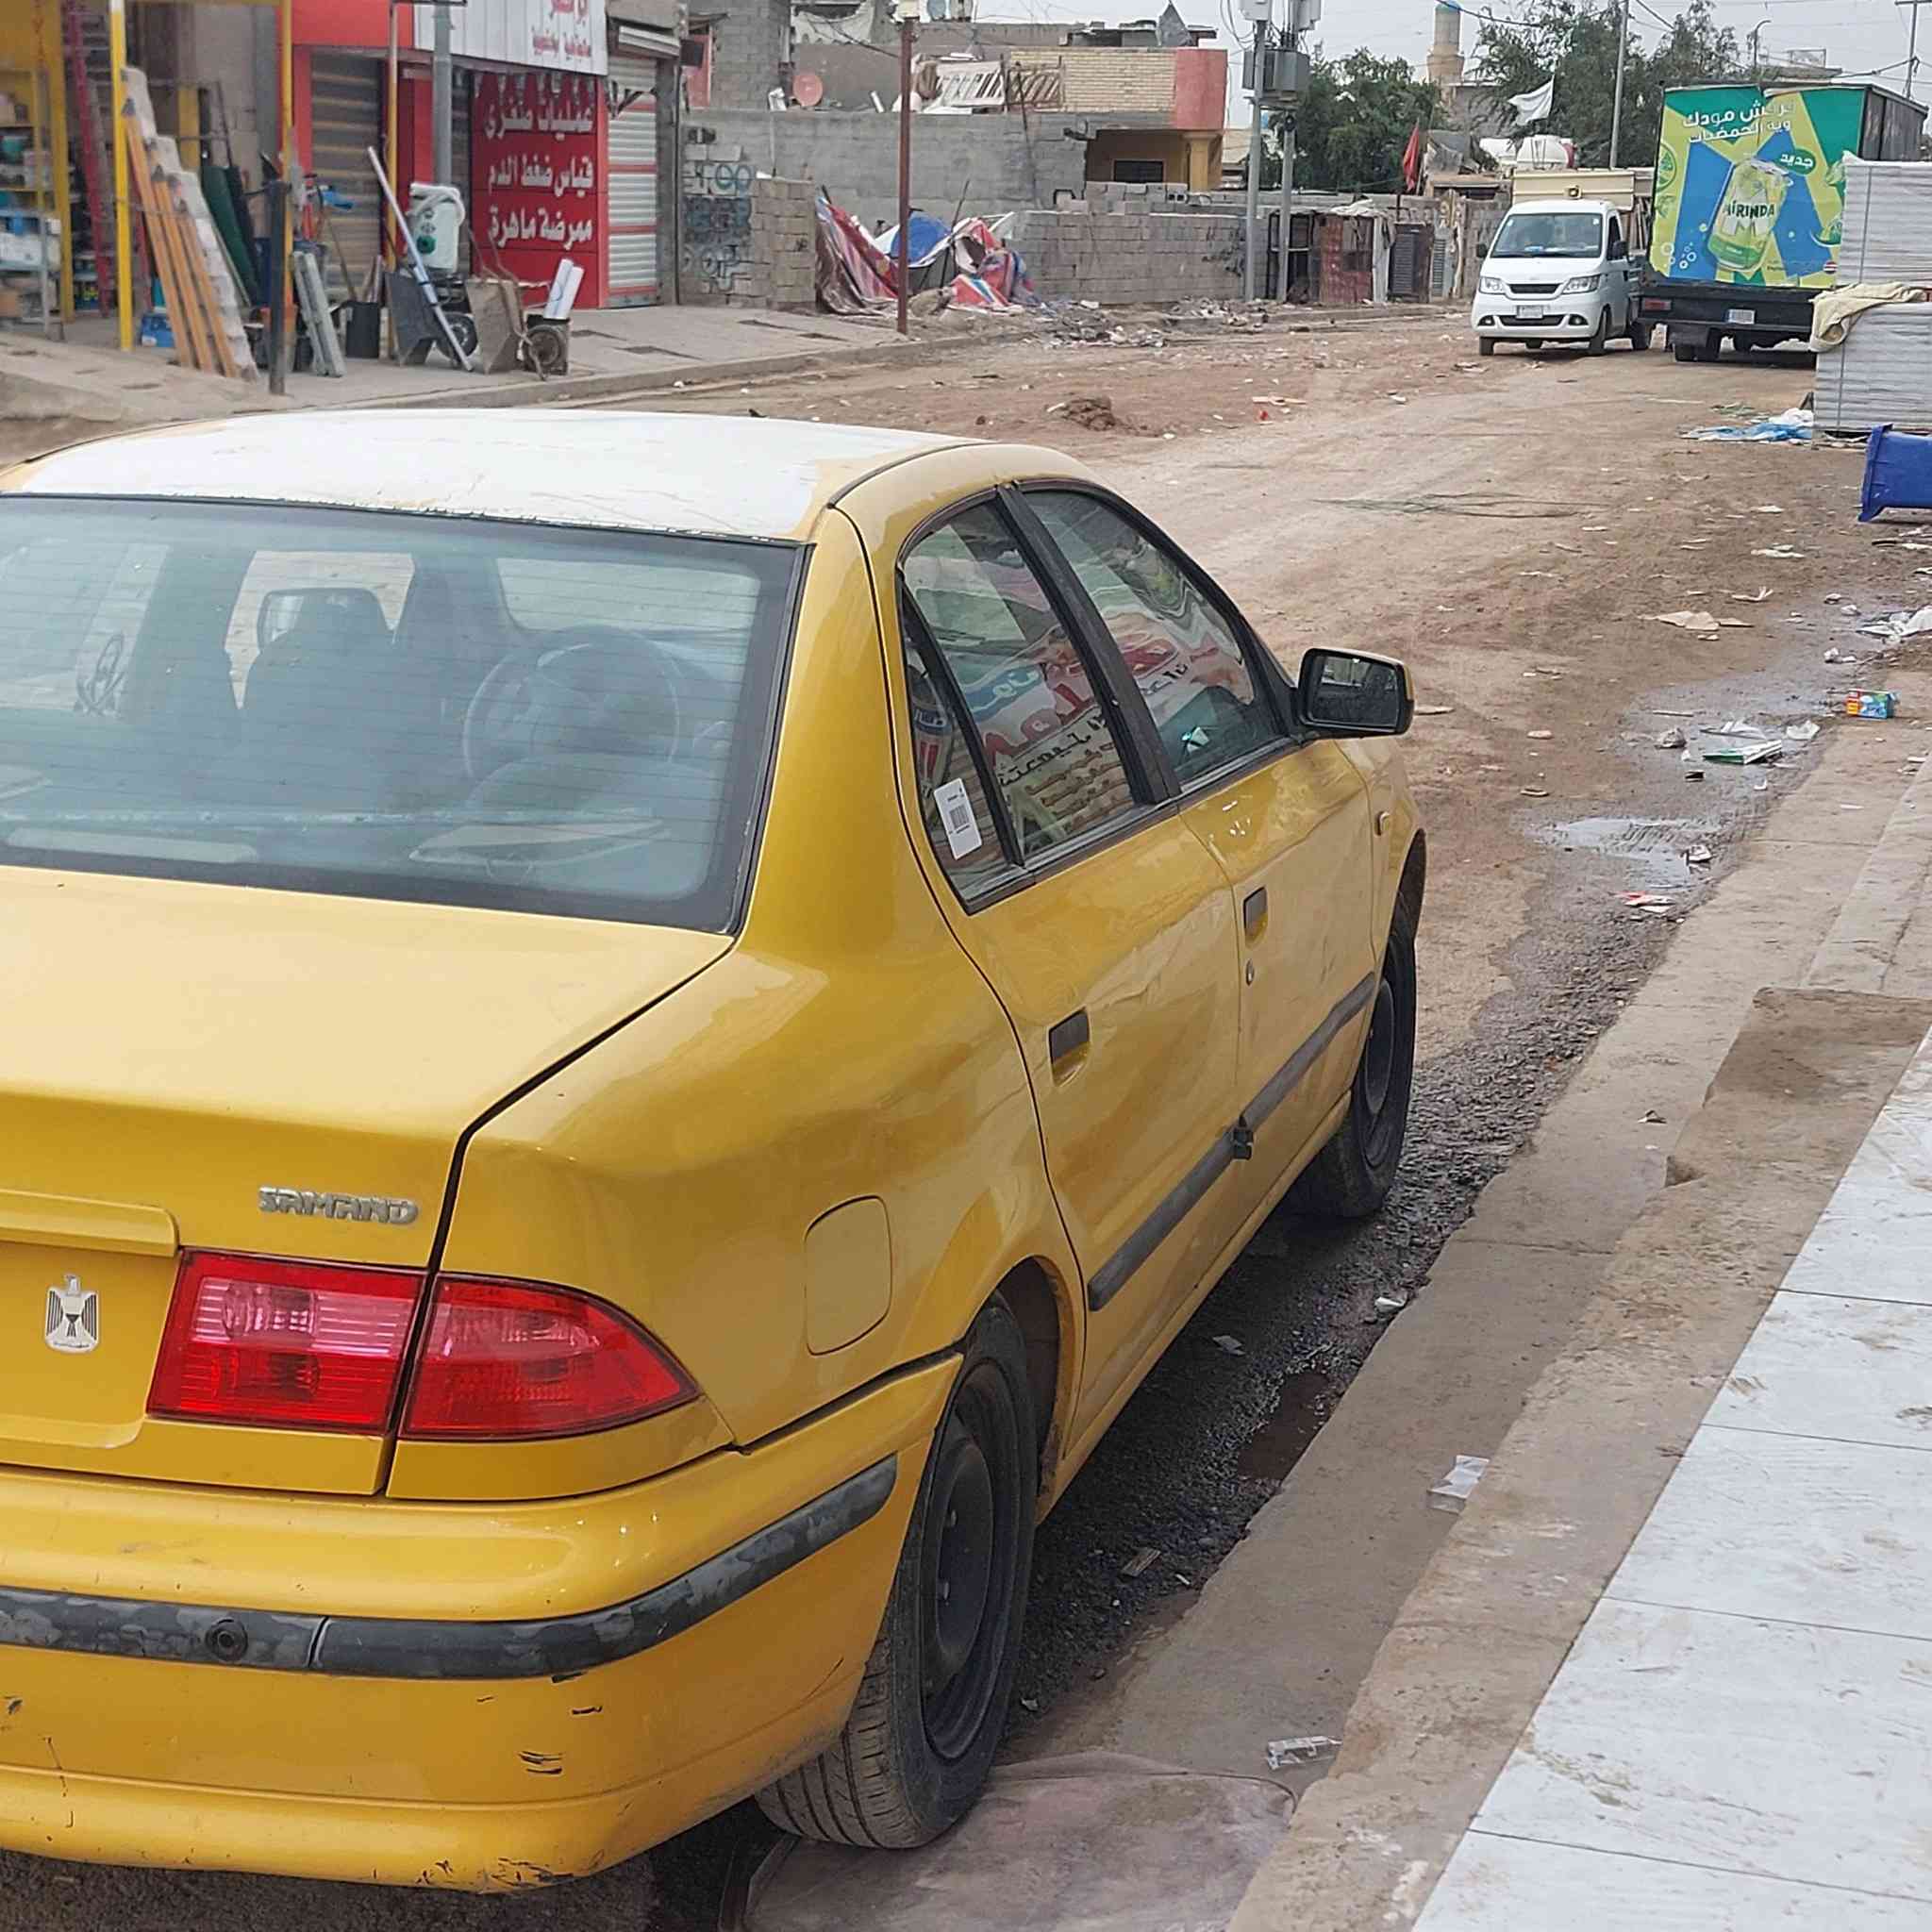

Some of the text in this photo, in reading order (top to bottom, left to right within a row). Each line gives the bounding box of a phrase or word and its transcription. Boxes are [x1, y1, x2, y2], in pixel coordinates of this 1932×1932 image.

[489, 154, 593, 197] قياس ضغط الدم
[1780, 153, 1814, 168] جديد
[489, 205, 593, 251] ممرضة ماهرة
[258, 1186, 419, 1225] SAMAND
